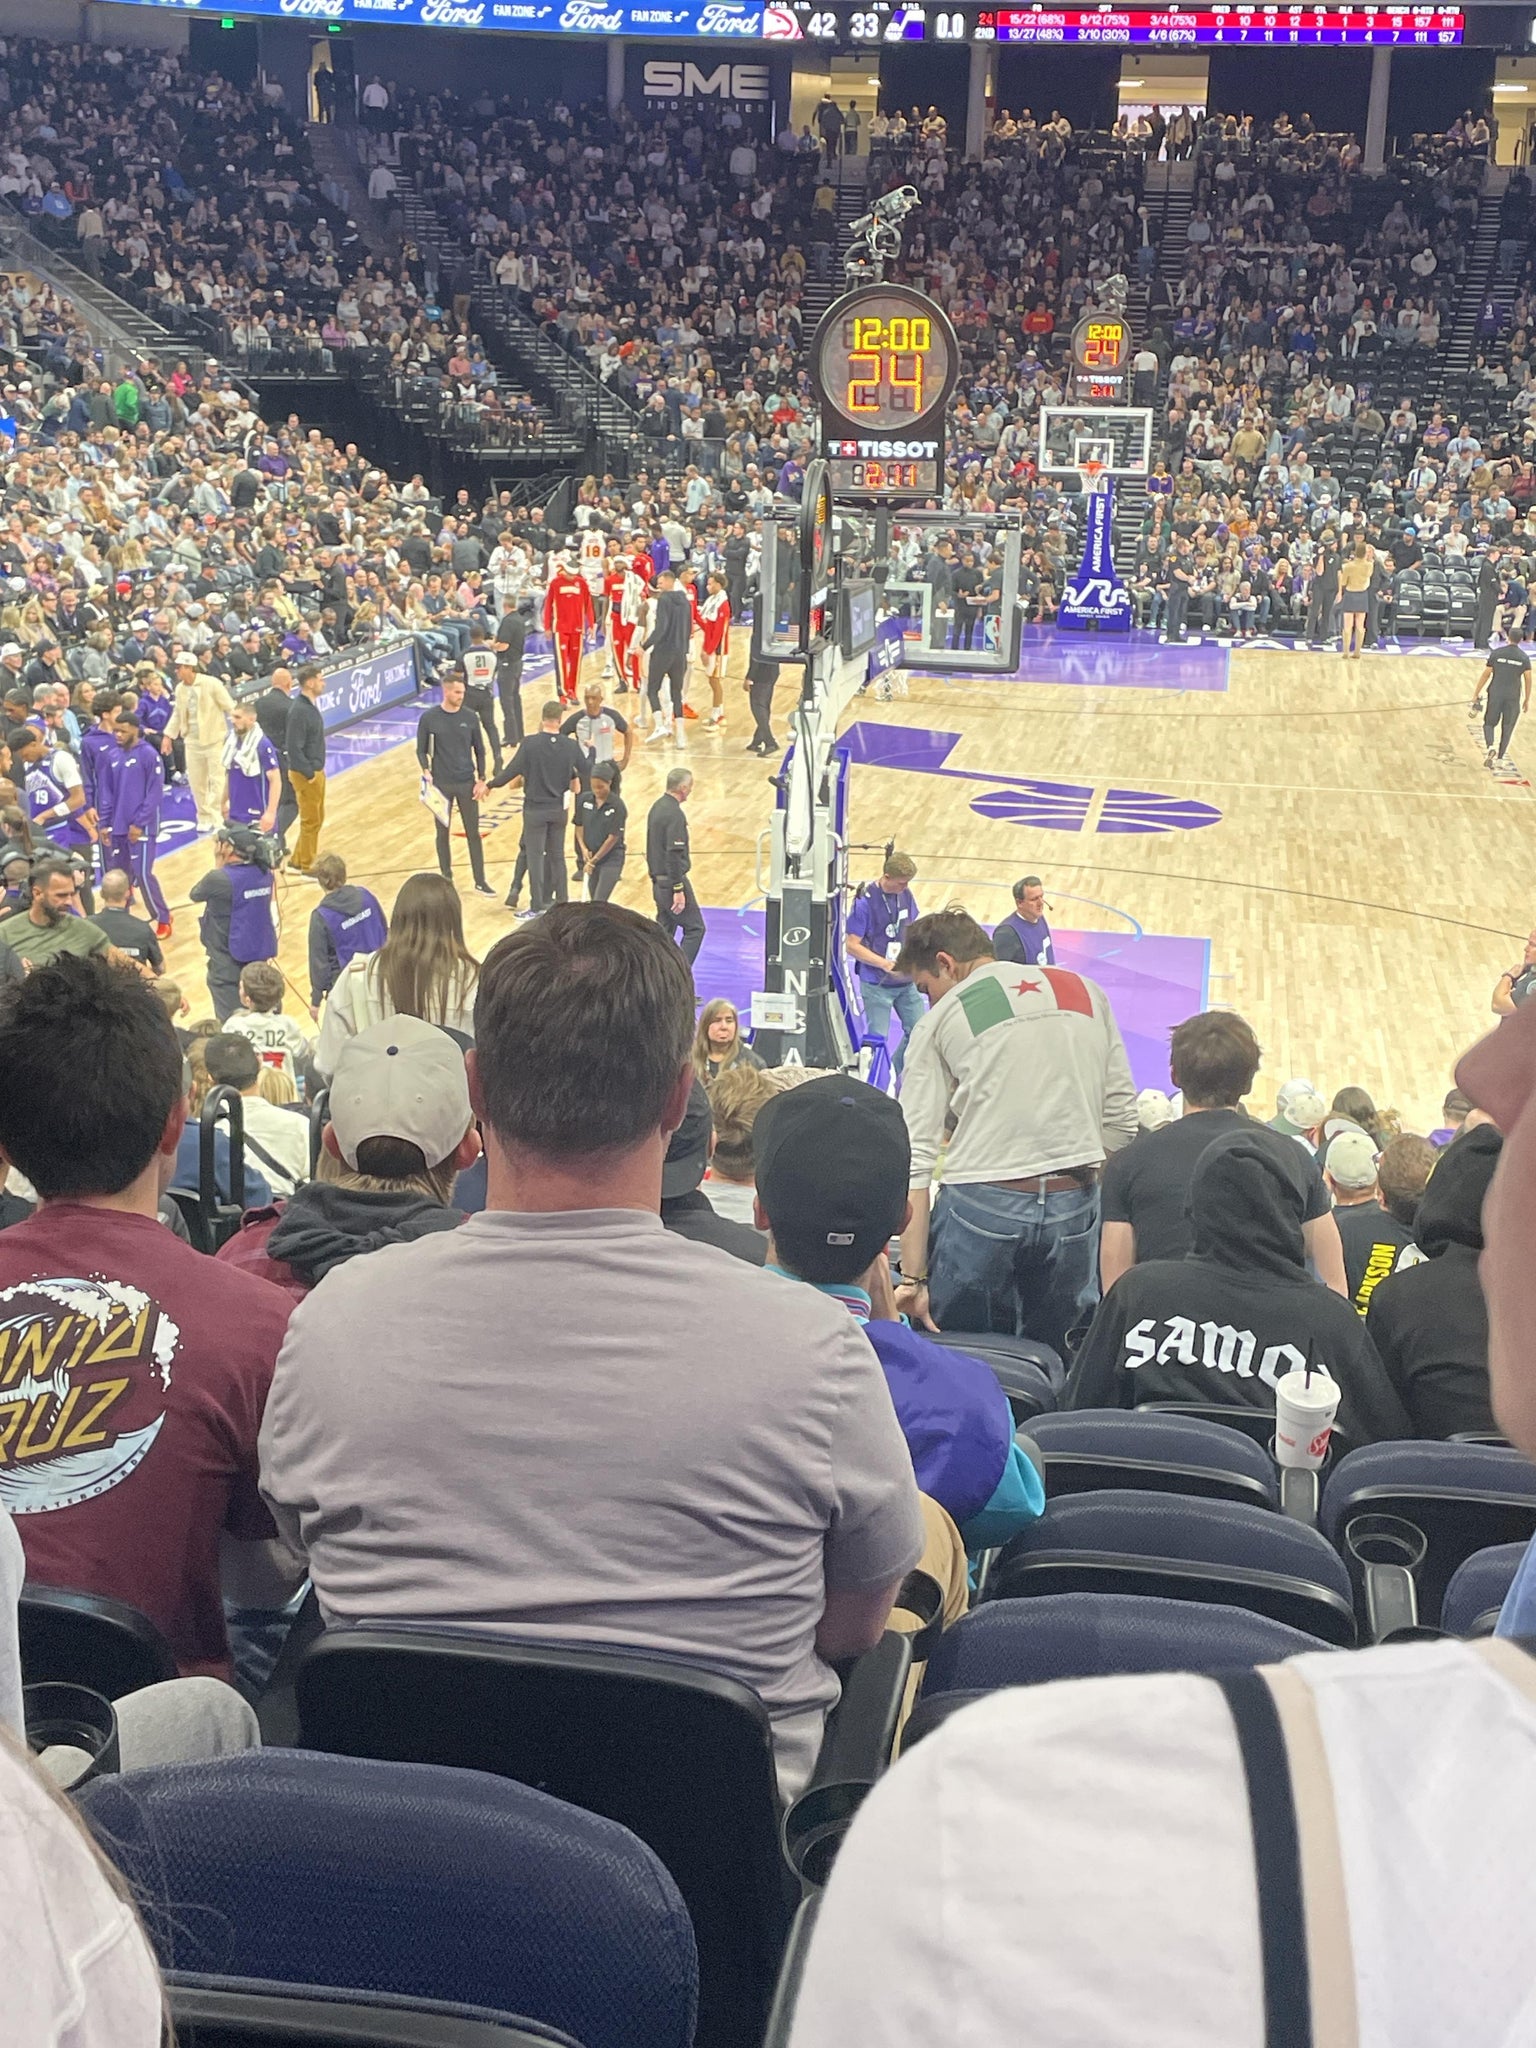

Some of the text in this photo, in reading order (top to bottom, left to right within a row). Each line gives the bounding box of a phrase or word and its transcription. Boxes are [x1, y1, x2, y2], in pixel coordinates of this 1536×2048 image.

[493, 4, 536, 18] FAN ZONE
[559, 0, 623, 31] Ford
[631, 10, 673, 24] FAN ZONE
[697, 4, 760, 34] Ford
[978, 12, 994, 25] 24
[807, 12, 837, 38] 42
[851, 12, 879, 38] 33
[936, 13, 965, 39] 0.0
[1009, 14, 1037, 25] 15/22
[1038, 14, 1065, 25] (68%)
[1079, 14, 1100, 25] 9/12
[1103, 14, 1129, 25] (75%)
[1150, 14, 1168, 25] 3/4
[1170, 15, 1196, 26] (75%)
[1216, 15, 1224, 26] 0
[1239, 15, 1251, 26] 10
[1264, 15, 1276, 26] 10
[1289, 15, 1301, 26] 12
[1316, 15, 1324, 26] 3
[1366, 15, 1374, 26] 3
[1414, 15, 1431, 26] 157
[1441, 15, 1454, 26] 111
[975, 26, 995, 39] 2ND
[1008, 29, 1036, 40] 13/27
[1037, 29, 1064, 40] (48%)
[1078, 29, 1100, 40] 3/10
[1102, 29, 1129, 40] (30%)
[1149, 29, 1167, 40] 4/6
[1169, 30, 1196, 41] (67%)
[1215, 30, 1223, 41] 4
[1240, 30, 1248, 41] 7
[1264, 30, 1274, 41] 11
[1289, 30, 1298, 41] 11
[1364, 30, 1373, 41] 4
[1392, 30, 1400, 41] 7
[1414, 30, 1428, 41] 111
[1438, 30, 1455, 41] 157
[643, 61, 769, 99] SME
[854, 317, 931, 351] 12:00
[1088, 325, 1122, 340] 12:00
[1084, 340, 1118, 365] 24
[848, 352, 923, 413] 24
[1090, 384, 1114, 398] 2:11
[858, 441, 938, 458] TISSOT
[1092, 496, 1106, 573] AMERICA FIRST
[586, 545, 600, 557] 18
[1064, 606, 1124, 616] AMERICA FIRST
[475, 655, 486, 668] 21
[349, 667, 382, 713] Ford
[35, 789, 49, 805] 19
[234, 1030, 286, 1047] 2-D2
[11, 1449, 147, 1512] SKATEBOARDS
